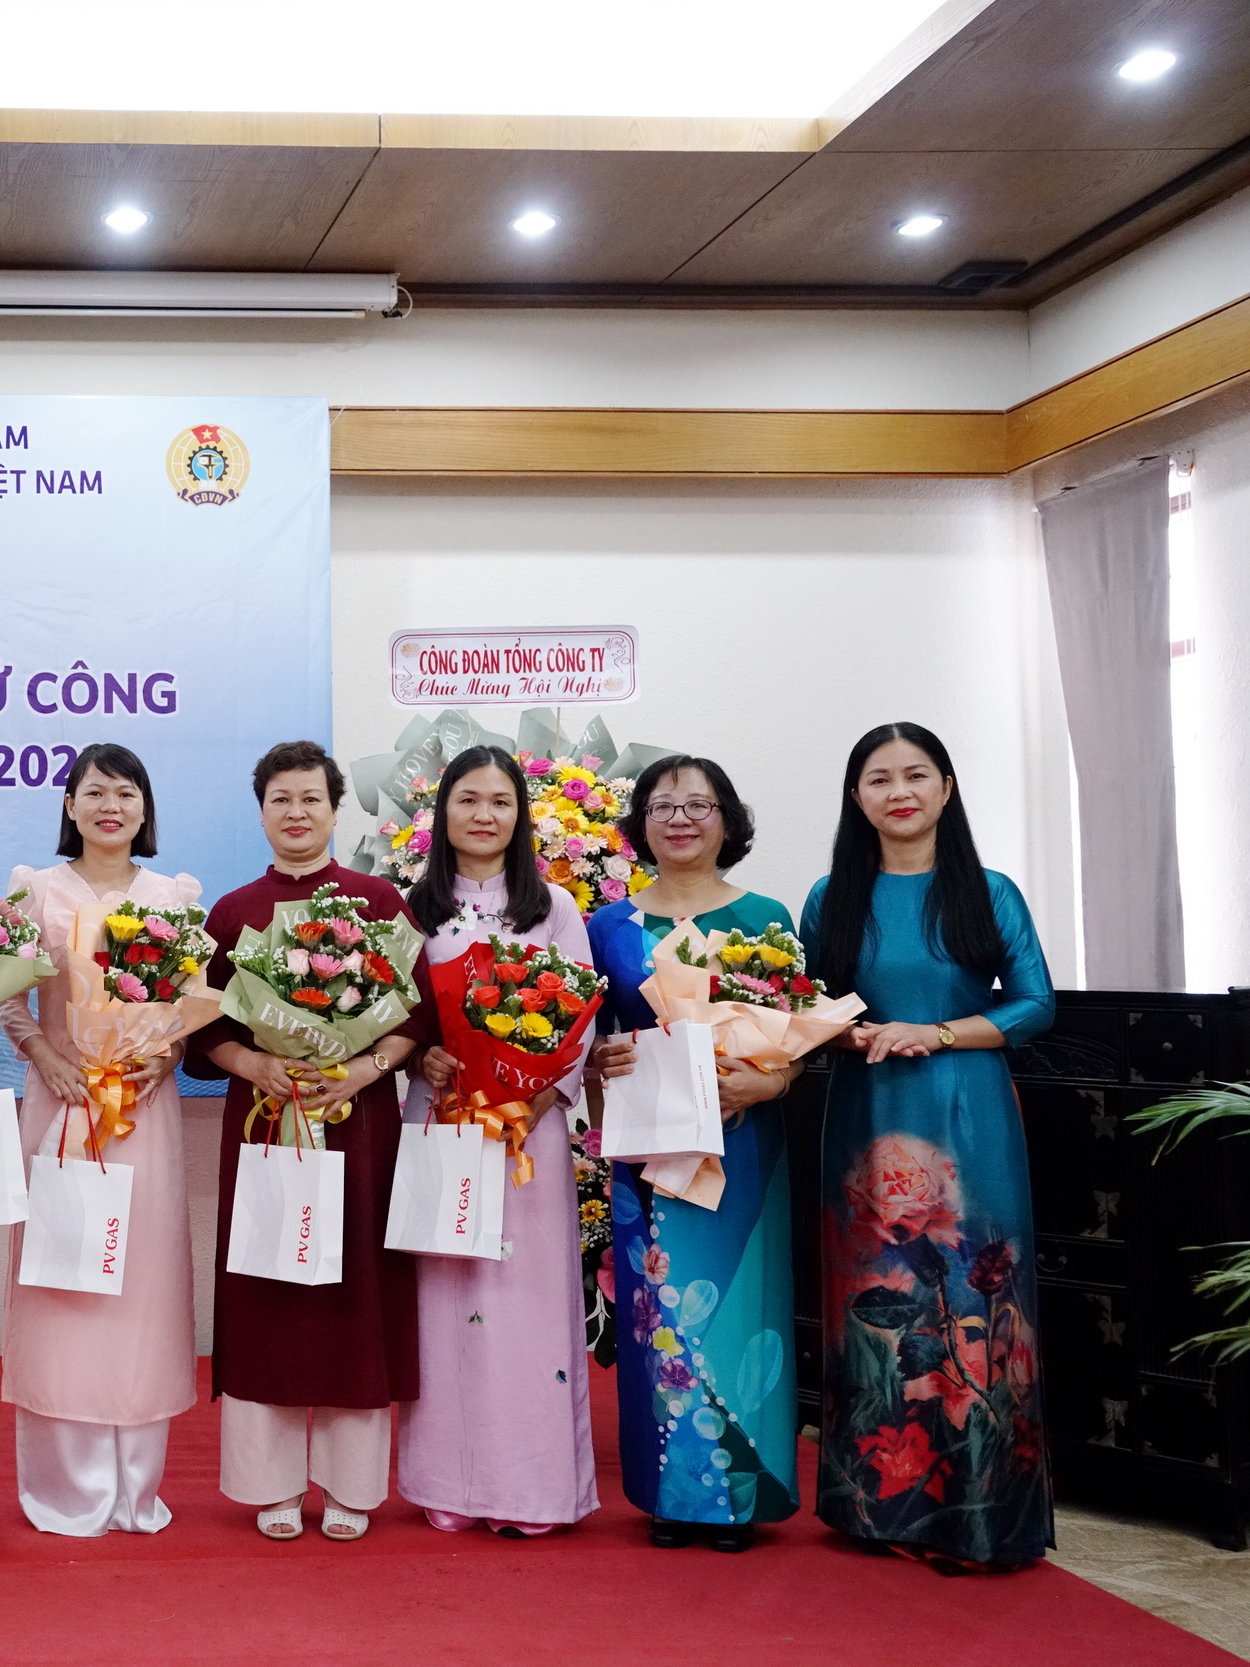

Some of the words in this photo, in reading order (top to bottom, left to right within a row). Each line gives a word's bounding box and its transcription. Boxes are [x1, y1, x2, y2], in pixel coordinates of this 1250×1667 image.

[36, 470, 103, 494] NAM
[418, 644, 458, 675] CÔNG
[462, 643, 500, 675] ĐOÀN
[504, 637, 542, 674] TỔNG
[546, 642, 586, 673] CÔNG
[589, 647, 606, 672] TY
[26, 660, 178, 715] CÔNG
[417, 677, 458, 696] Chúc
[462, 677, 511, 698] Mừng
[518, 676, 551, 698] Hội
[557, 674, 604, 697] Nghị
[458, 1177, 471, 1211] GAS
[105, 1217, 120, 1251] GAS
[300, 1205, 312, 1239] GAS
[456, 1212, 468, 1235] PV
[103, 1252, 116, 1275] PV
[297, 1241, 309, 1264] PV
